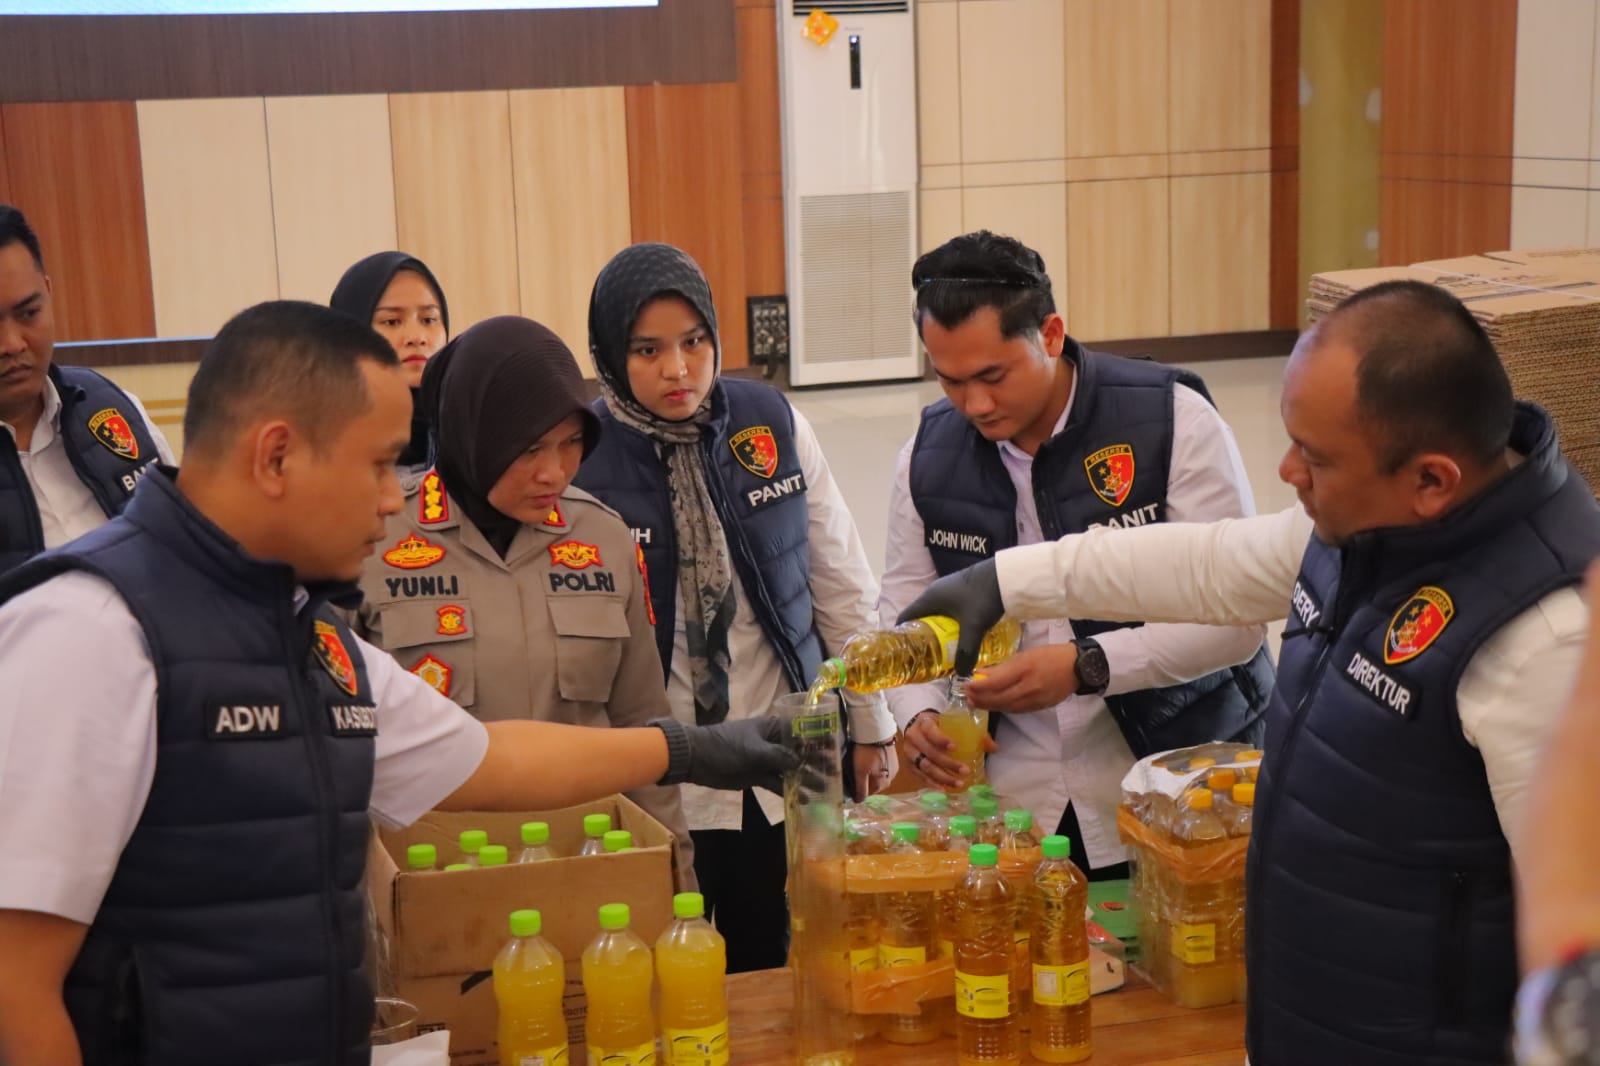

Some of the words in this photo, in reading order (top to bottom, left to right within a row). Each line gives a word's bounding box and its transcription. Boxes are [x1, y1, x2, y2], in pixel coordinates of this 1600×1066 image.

[747, 473, 802, 507] PANIT
[929, 528, 958, 549] JOHN
[960, 533, 988, 554] WICK
[548, 571, 615, 593] POLRI
[1347, 653, 1410, 715] DIREKTUR
[215, 705, 281, 733] ADW
